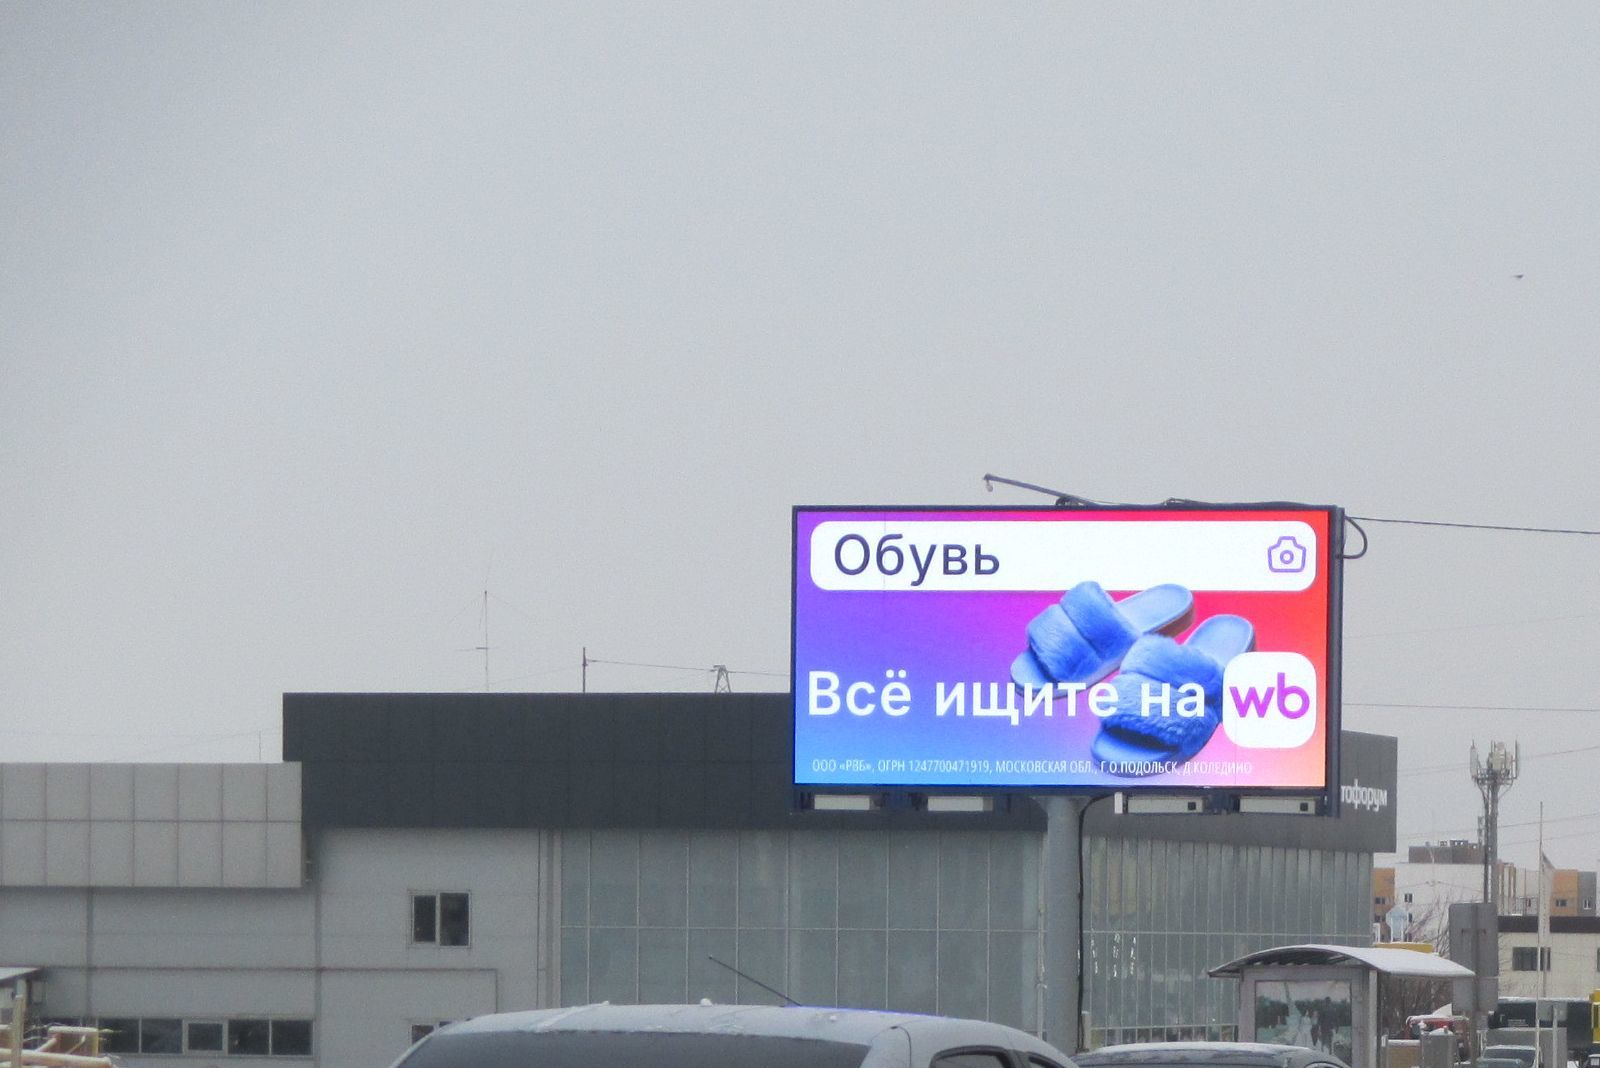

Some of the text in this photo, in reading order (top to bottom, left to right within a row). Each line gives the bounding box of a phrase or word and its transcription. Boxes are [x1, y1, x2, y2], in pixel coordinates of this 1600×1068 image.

[834, 533, 1000, 587] Обувь
[808, 669, 1206, 726] Всё ищите на
[1228, 671, 1311, 720] wb
[812, 758, 837, 773] ООО
[877, 758, 905, 773] ОГРН
[995, 758, 1067, 774] МОСКОВСКАЯ
